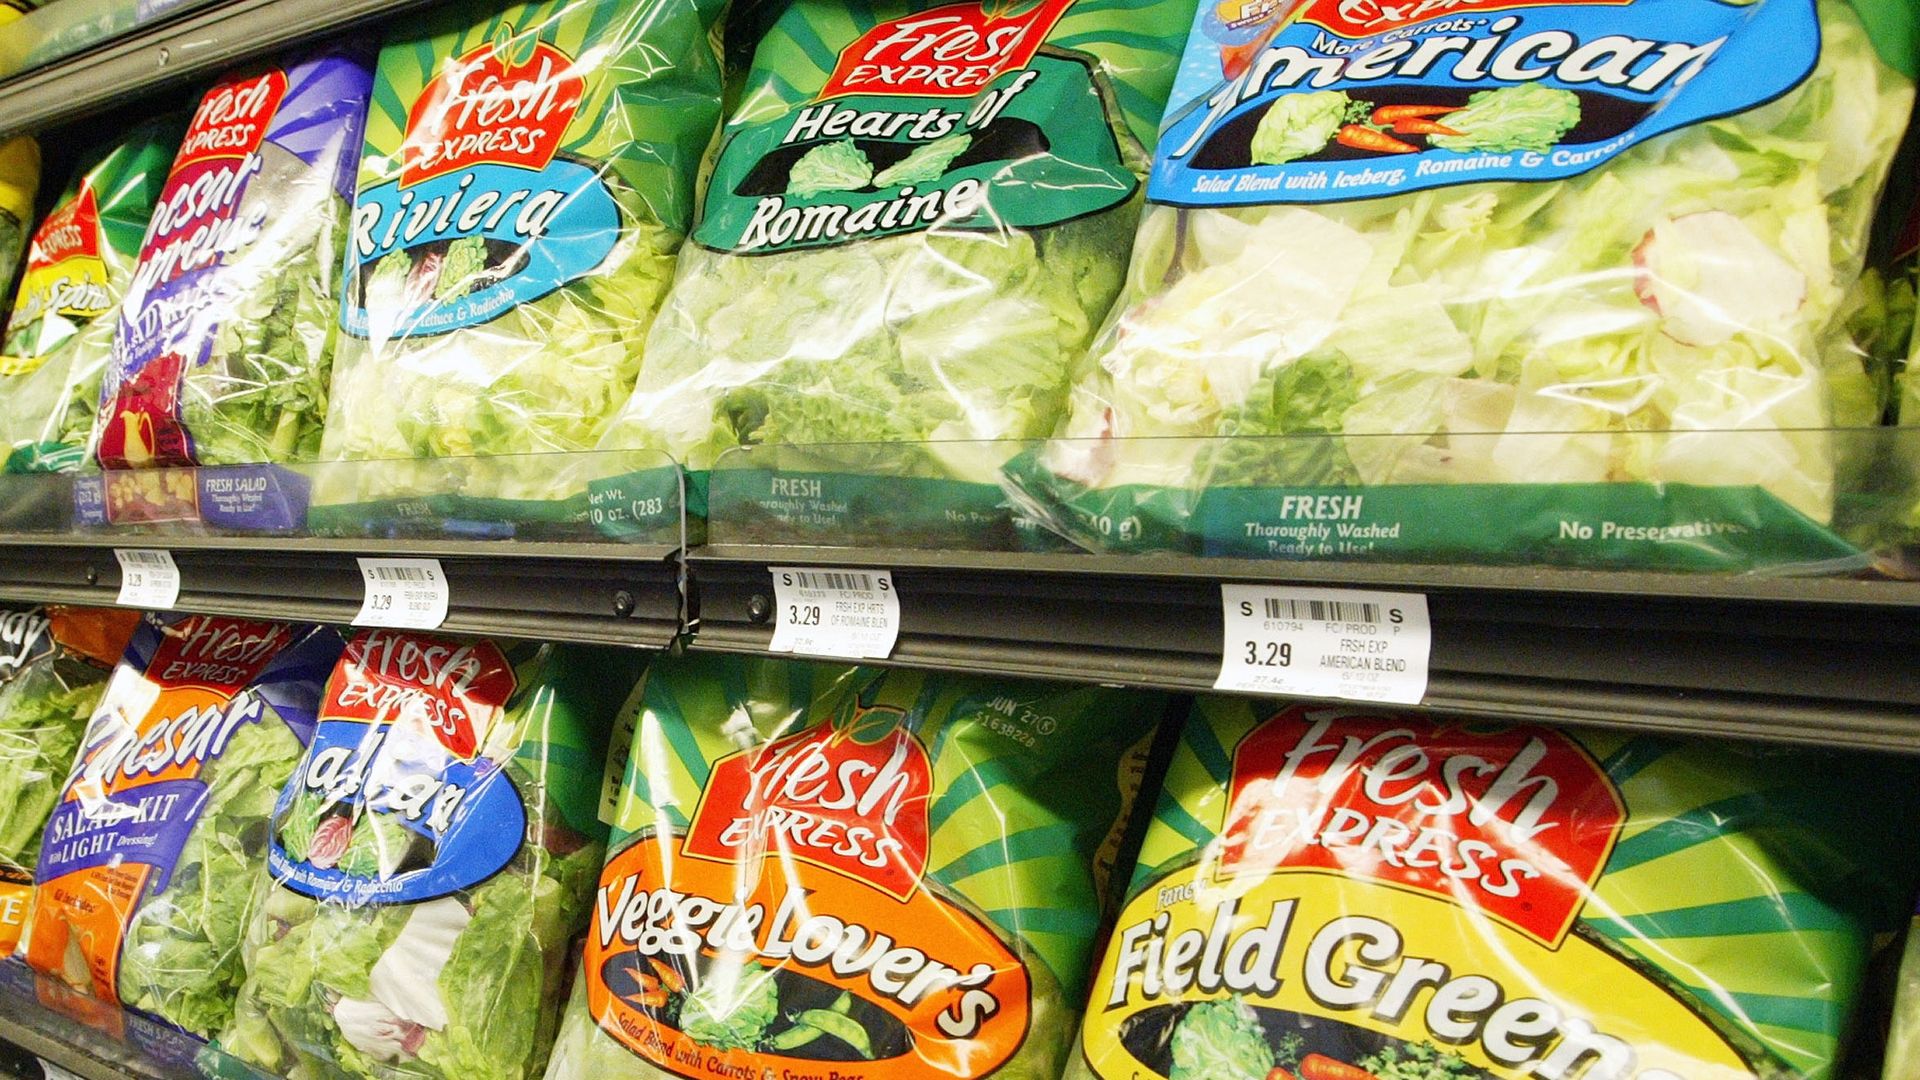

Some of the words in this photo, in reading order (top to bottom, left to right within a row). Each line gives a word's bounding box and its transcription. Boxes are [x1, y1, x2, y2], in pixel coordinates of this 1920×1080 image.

[1311, 30, 1373, 55] More
[195, 73, 272, 130] resh
[430, 55, 560, 135] Fresh
[783, 103, 961, 145] Hearts
[967, 70, 1038, 128] of
[184, 123, 256, 155] XPRESS
[420, 126, 545, 170] EXPRESS
[1191, 175, 1231, 194] Salad
[1233, 173, 1279, 193] Blend
[1287, 172, 1327, 190] with
[1332, 167, 1407, 190] Iceberg,
[1416, 154, 1512, 177] Romaine
[1520, 151, 1543, 168] &
[355, 173, 567, 256] Riviera
[739, 179, 982, 248] Romaine
[457, 306, 467, 321] &
[206, 477, 234, 493] FRESH
[235, 475, 267, 492] SALAD
[605, 489, 626, 501] Wt.
[771, 477, 822, 498] FRESH
[632, 496, 663, 522] (283
[1280, 495, 1364, 520] FRESH
[1118, 514, 1142, 541] g)
[1245, 522, 1332, 541] Thoroughly
[1336, 521, 1401, 539] Washed
[1559, 520, 1593, 540] No
[1267, 539, 1315, 557] Ready
[1318, 541, 1334, 555] to
[782, 573, 793, 587] S
[877, 577, 890, 591] S
[789, 604, 820, 626] 3.29
[1240, 601, 1254, 617] S
[1389, 608, 1404, 624] S
[1244, 640, 1292, 668] 3.29
[1340, 638, 1365, 653] FRSH
[1367, 640, 1389, 654] EXP
[162, 659, 248, 685] EXPRESS
[1319, 655, 1373, 671] AMERICAN
[1374, 658, 1406, 672] BLEND
[986, 695, 1017, 717] JUN
[742, 731, 910, 828] Fresh
[1272, 710, 1561, 844] Fresh
[132, 793, 180, 824] KIT
[61, 831, 119, 864] LIGHT
[718, 806, 903, 868] EXPRESS
[1252, 805, 1540, 899] EXPRESS
[598, 873, 765, 956] Veggie
[758, 886, 998, 1039] Lover's
[1103, 897, 1300, 1013] Field
[1304, 914, 1688, 1080] Green
[618, 1012, 643, 1040] Salad
[674, 1047, 702, 1071] with
